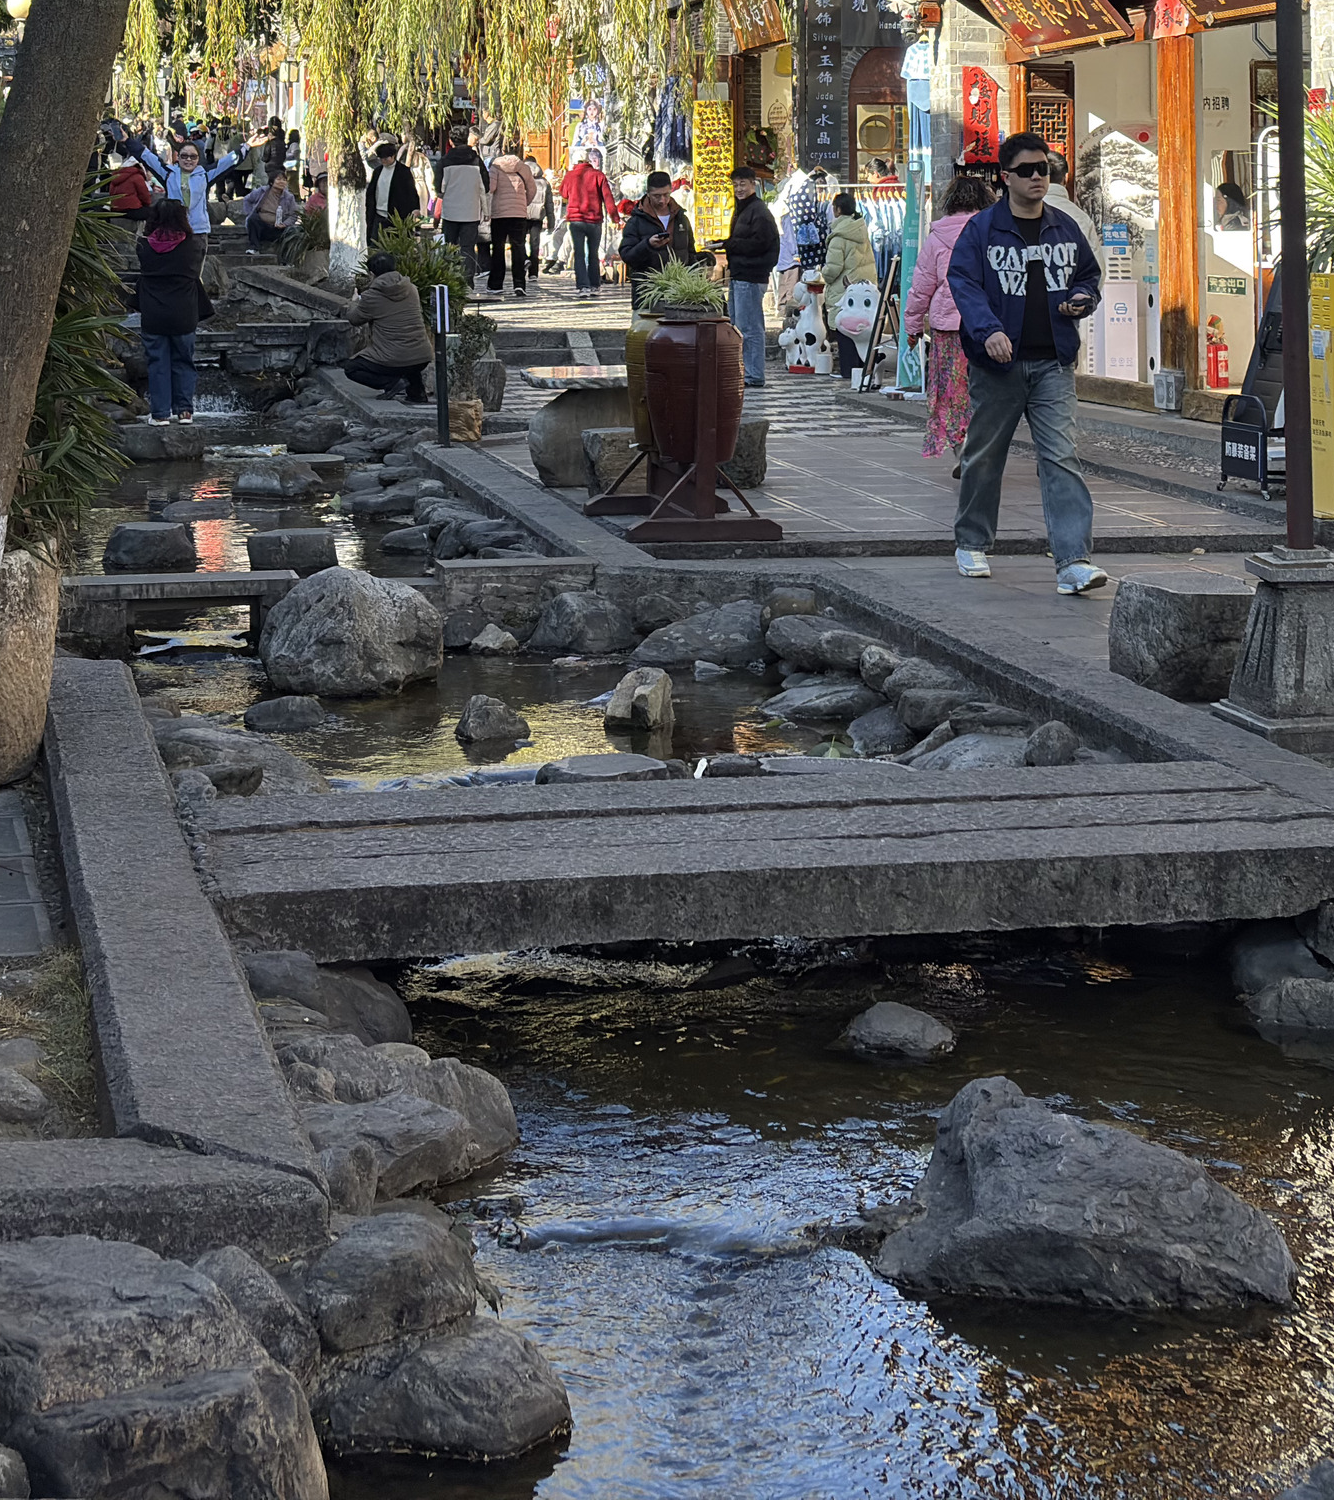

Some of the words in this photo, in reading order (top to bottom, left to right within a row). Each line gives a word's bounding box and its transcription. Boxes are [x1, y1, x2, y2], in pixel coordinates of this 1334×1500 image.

[812, 33, 837, 41] Silver
[816, 55, 834, 87] 玉饰
[815, 113, 835, 145] 水晶
[810, 150, 840, 164] crystal
[1208, 276, 1245, 288] 安全出口
[1224, 440, 1257, 462] 防暴装备架
